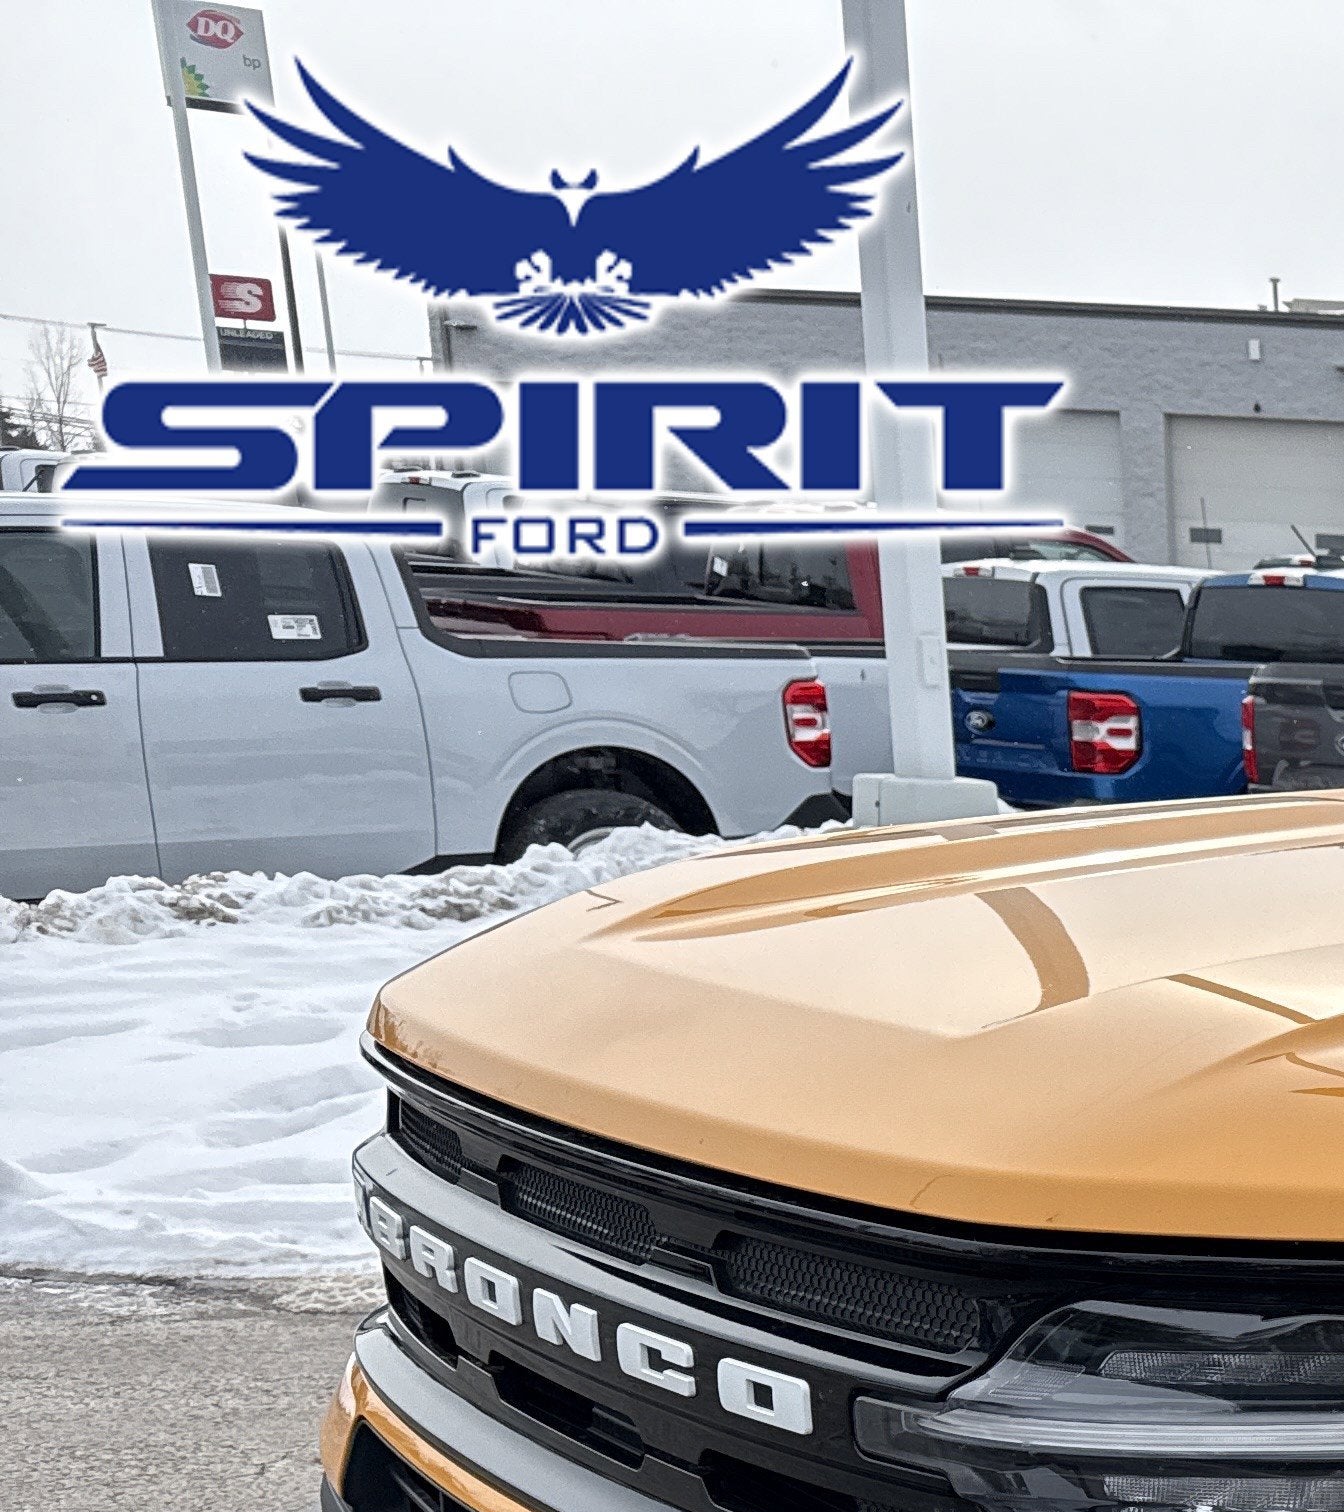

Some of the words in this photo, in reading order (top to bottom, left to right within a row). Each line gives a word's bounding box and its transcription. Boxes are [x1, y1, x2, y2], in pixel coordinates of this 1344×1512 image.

[197, 16, 234, 42] DQ
[242, 54, 261, 70] bp
[369, 1195, 814, 1435] BRONCO
